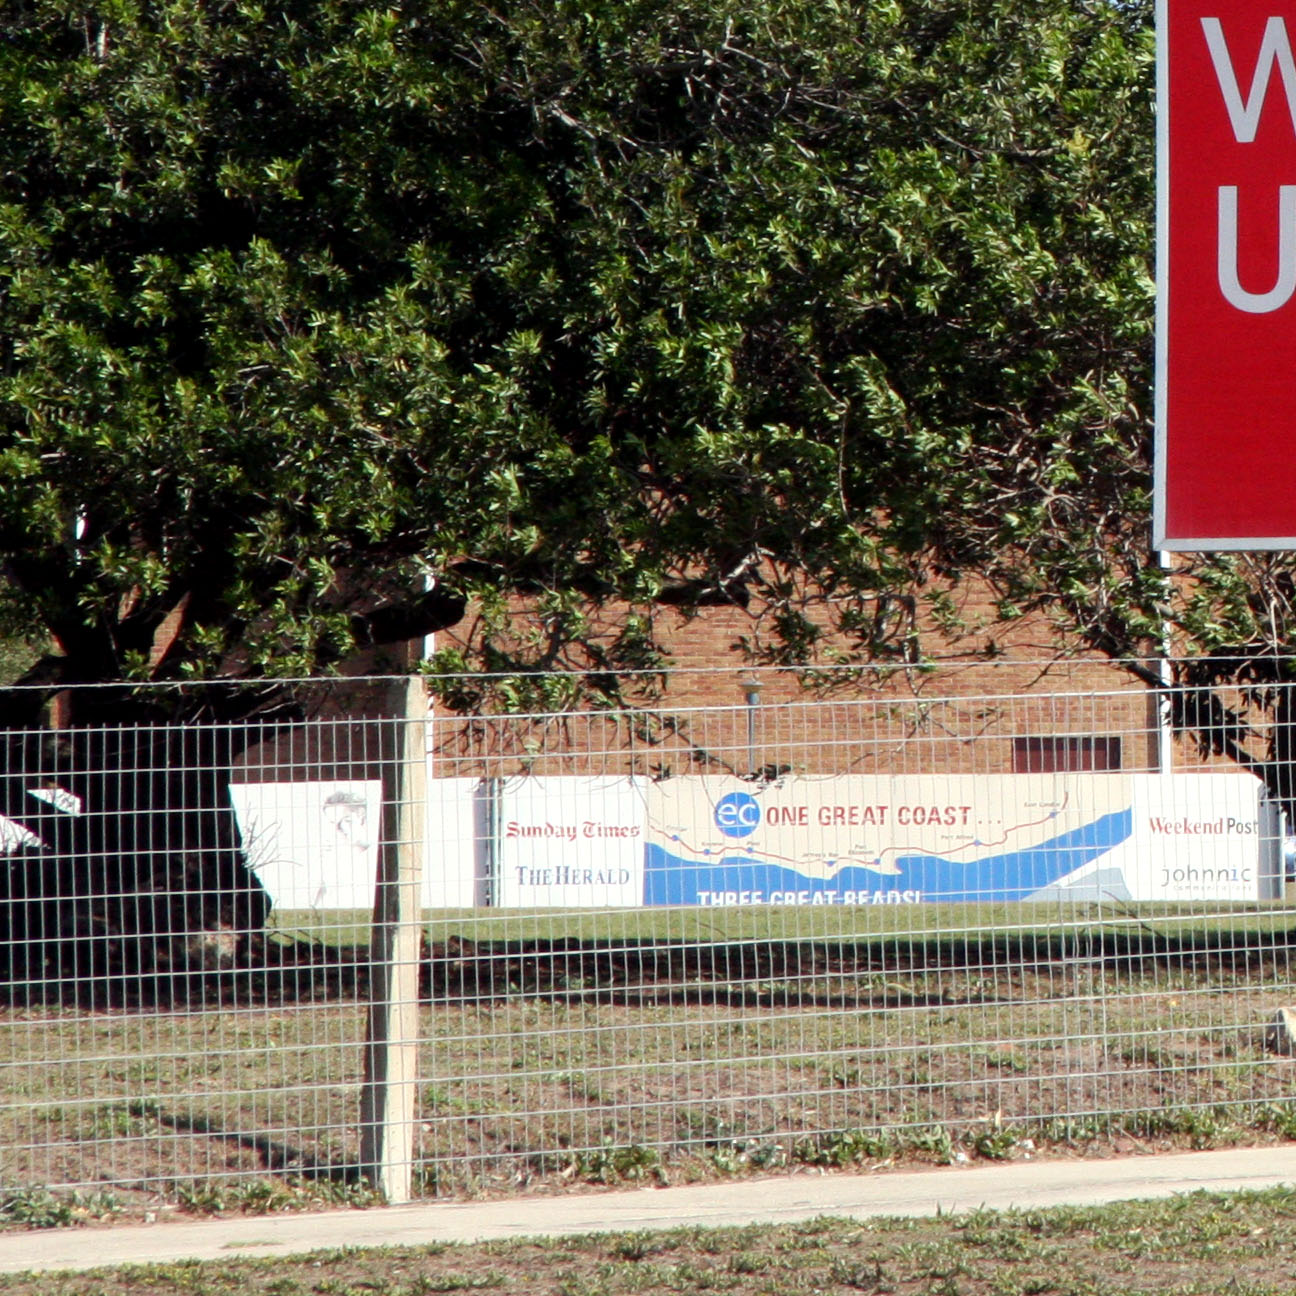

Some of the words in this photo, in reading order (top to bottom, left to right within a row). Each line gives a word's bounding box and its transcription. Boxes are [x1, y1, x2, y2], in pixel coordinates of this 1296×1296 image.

[766, 806, 808, 826] ONE
[818, 805, 888, 826] GREAT
[898, 805, 972, 826] COAST
[1149, 816, 1224, 835] Weekend
[1227, 817, 1258, 835] Post
[506, 821, 577, 842] Sunday
[582, 820, 641, 839] Times
[514, 865, 552, 886] THE
[555, 864, 631, 886] HERALD
[1160, 864, 1252, 887] johnnic
[696, 890, 763, 906] THREE
[769, 889, 838, 906] GREAT
